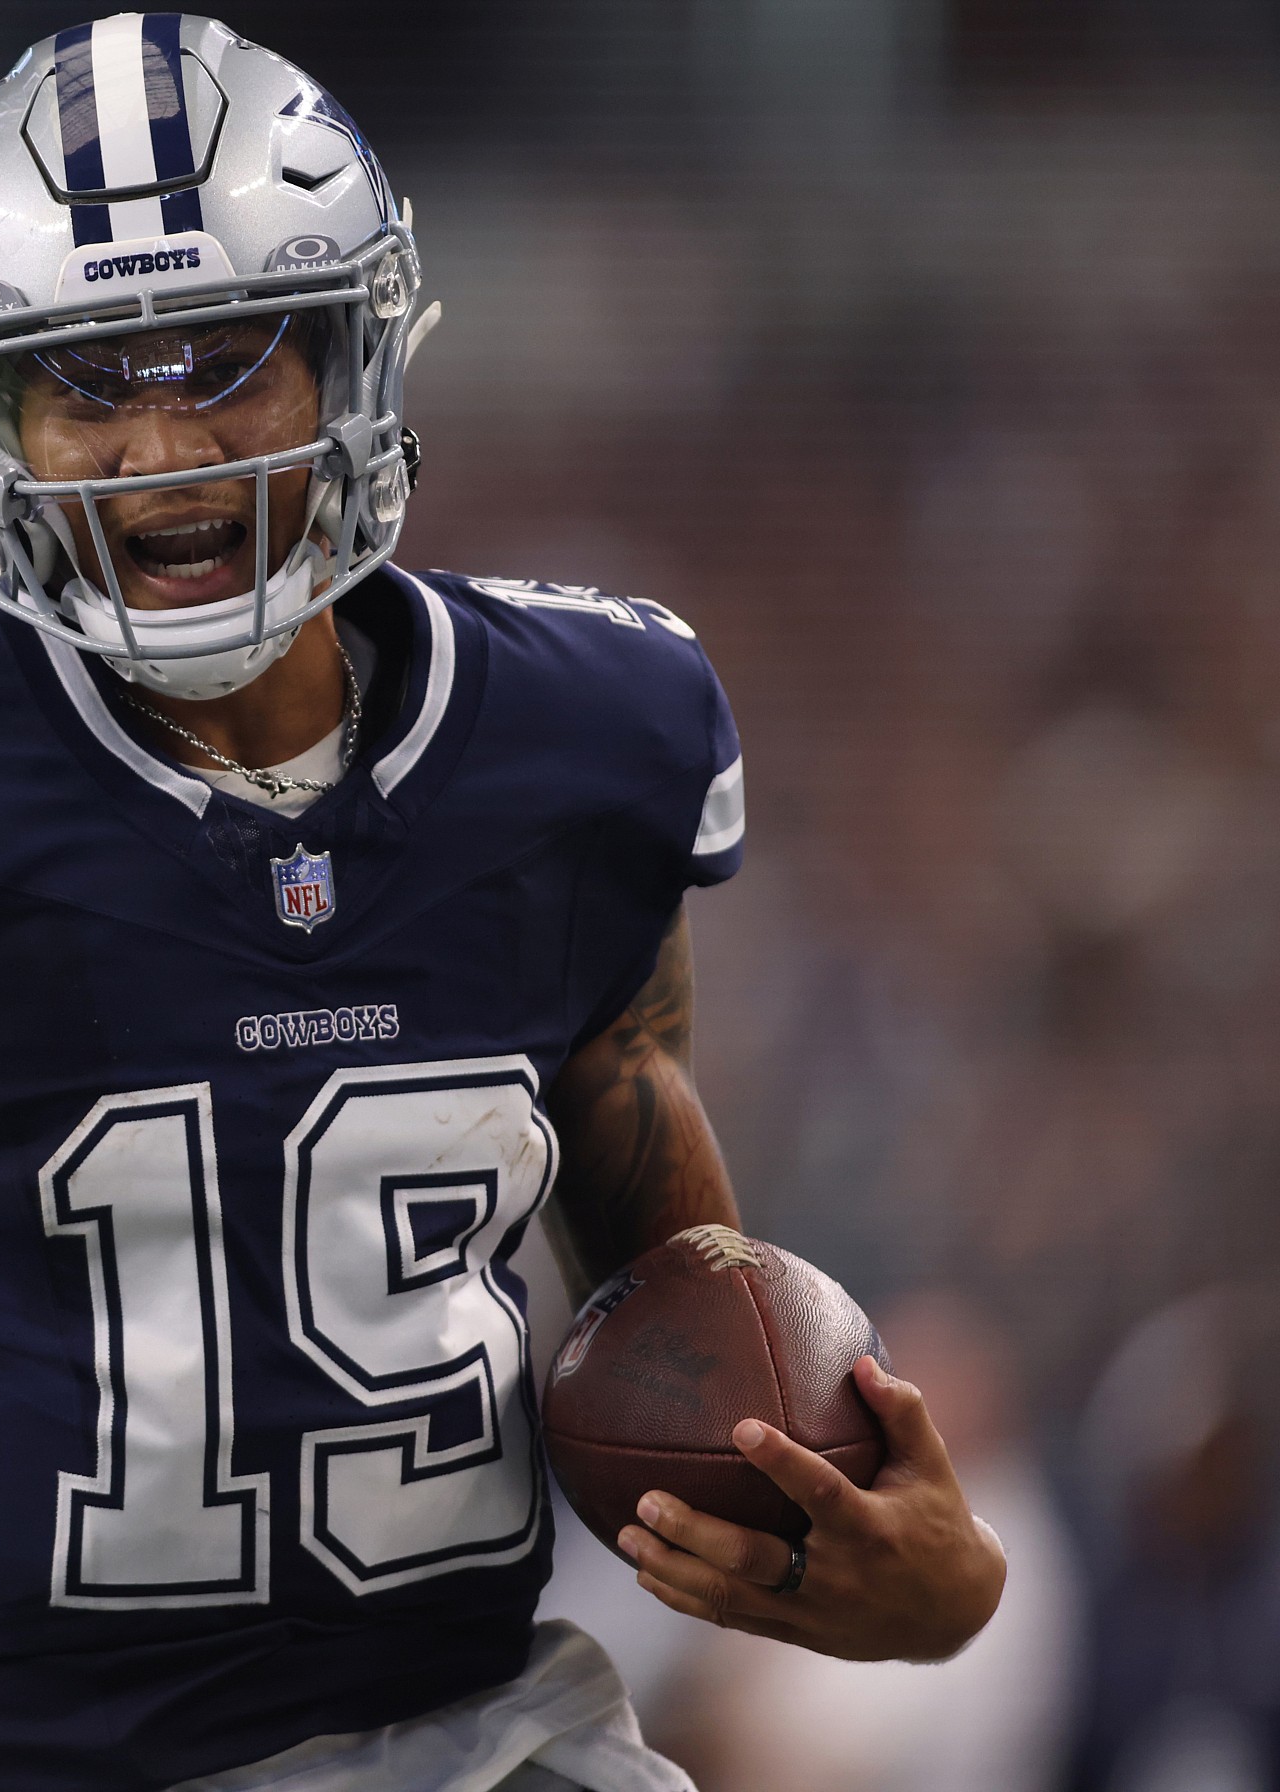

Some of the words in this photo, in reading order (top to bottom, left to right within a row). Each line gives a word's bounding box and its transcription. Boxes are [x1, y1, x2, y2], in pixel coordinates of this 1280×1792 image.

[83, 247, 201, 282] COWBOYS
[467, 576, 646, 632] 1
[284, 884, 328, 917] NFL
[235, 1004, 400, 1051] COWBOYS
[37, 1053, 561, 1611] 19
